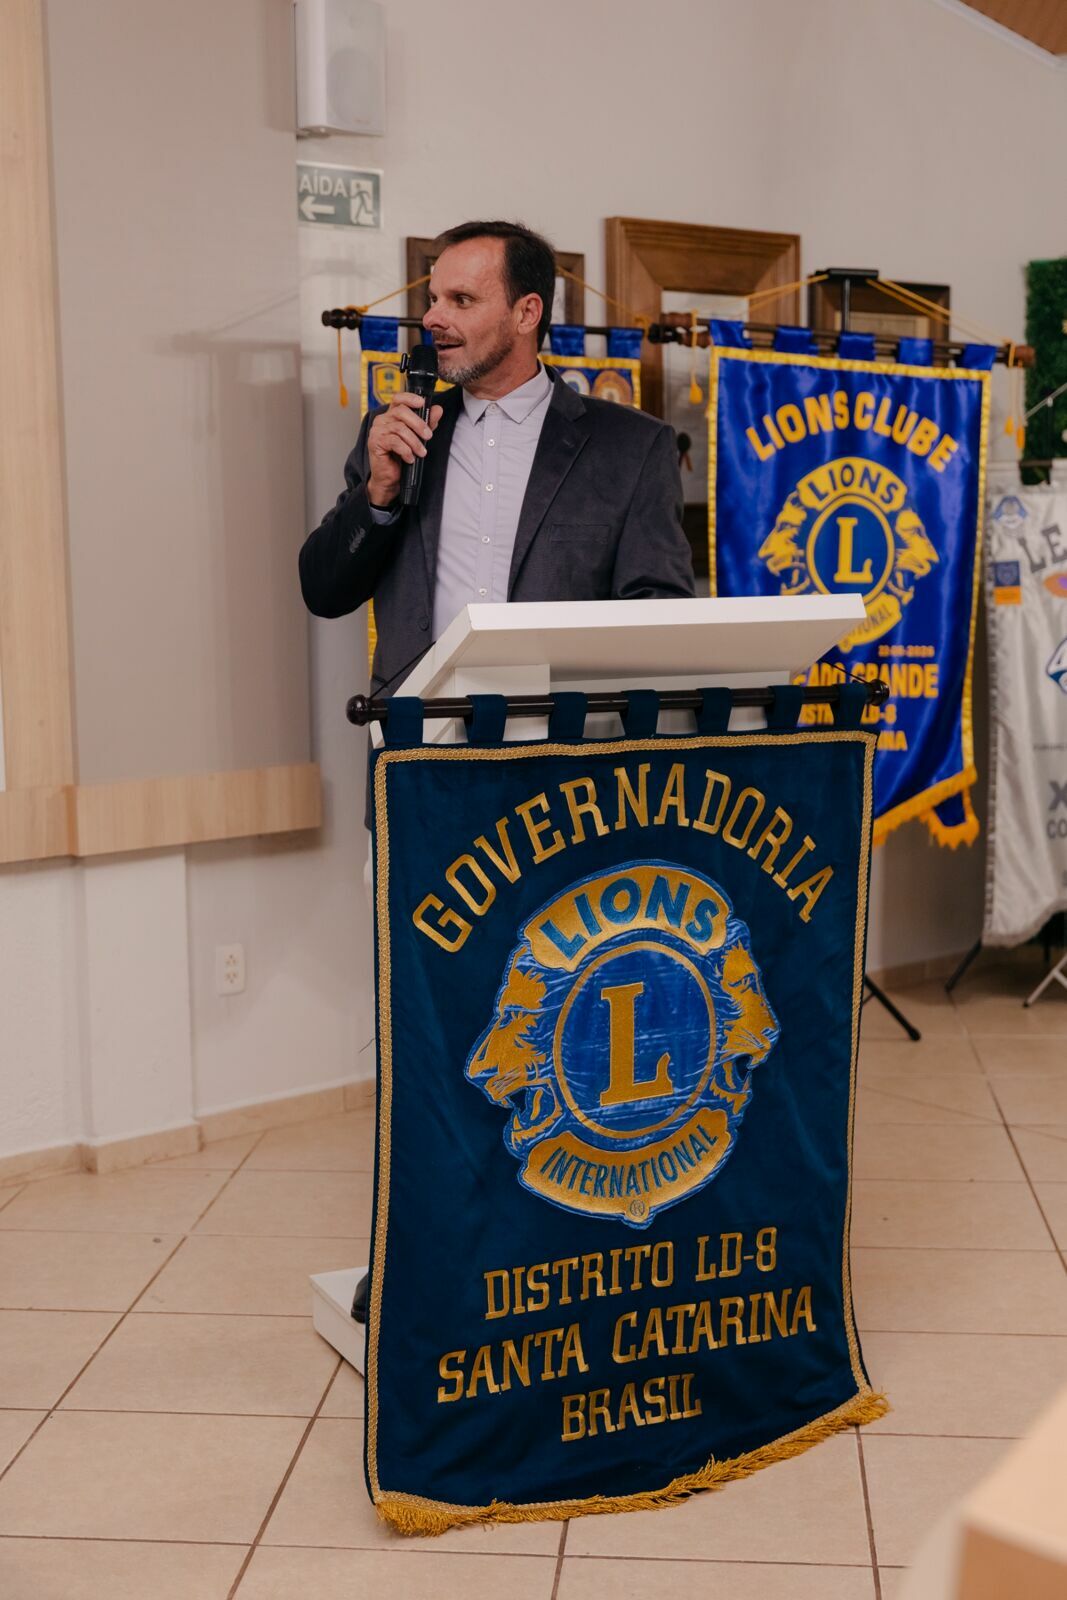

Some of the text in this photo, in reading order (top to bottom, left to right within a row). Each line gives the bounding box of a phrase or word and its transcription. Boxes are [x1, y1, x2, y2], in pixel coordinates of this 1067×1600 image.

[299, 169, 349, 198] AÍDA
[746, 390, 959, 473] LIONS CLUBE
[807, 463, 899, 504] LIONS
[833, 516, 874, 584] L
[412, 763, 834, 953] GOVERNADORIA
[539, 875, 720, 961] LIONS
[600, 981, 674, 1106] L
[540, 1124, 719, 1198] INTERNATIONAL
[483, 1226, 777, 1320] DISTRITO LD-8
[437, 1286, 817, 1403] SANTA CATARINA
[561, 1373, 702, 1442] BRASIL
